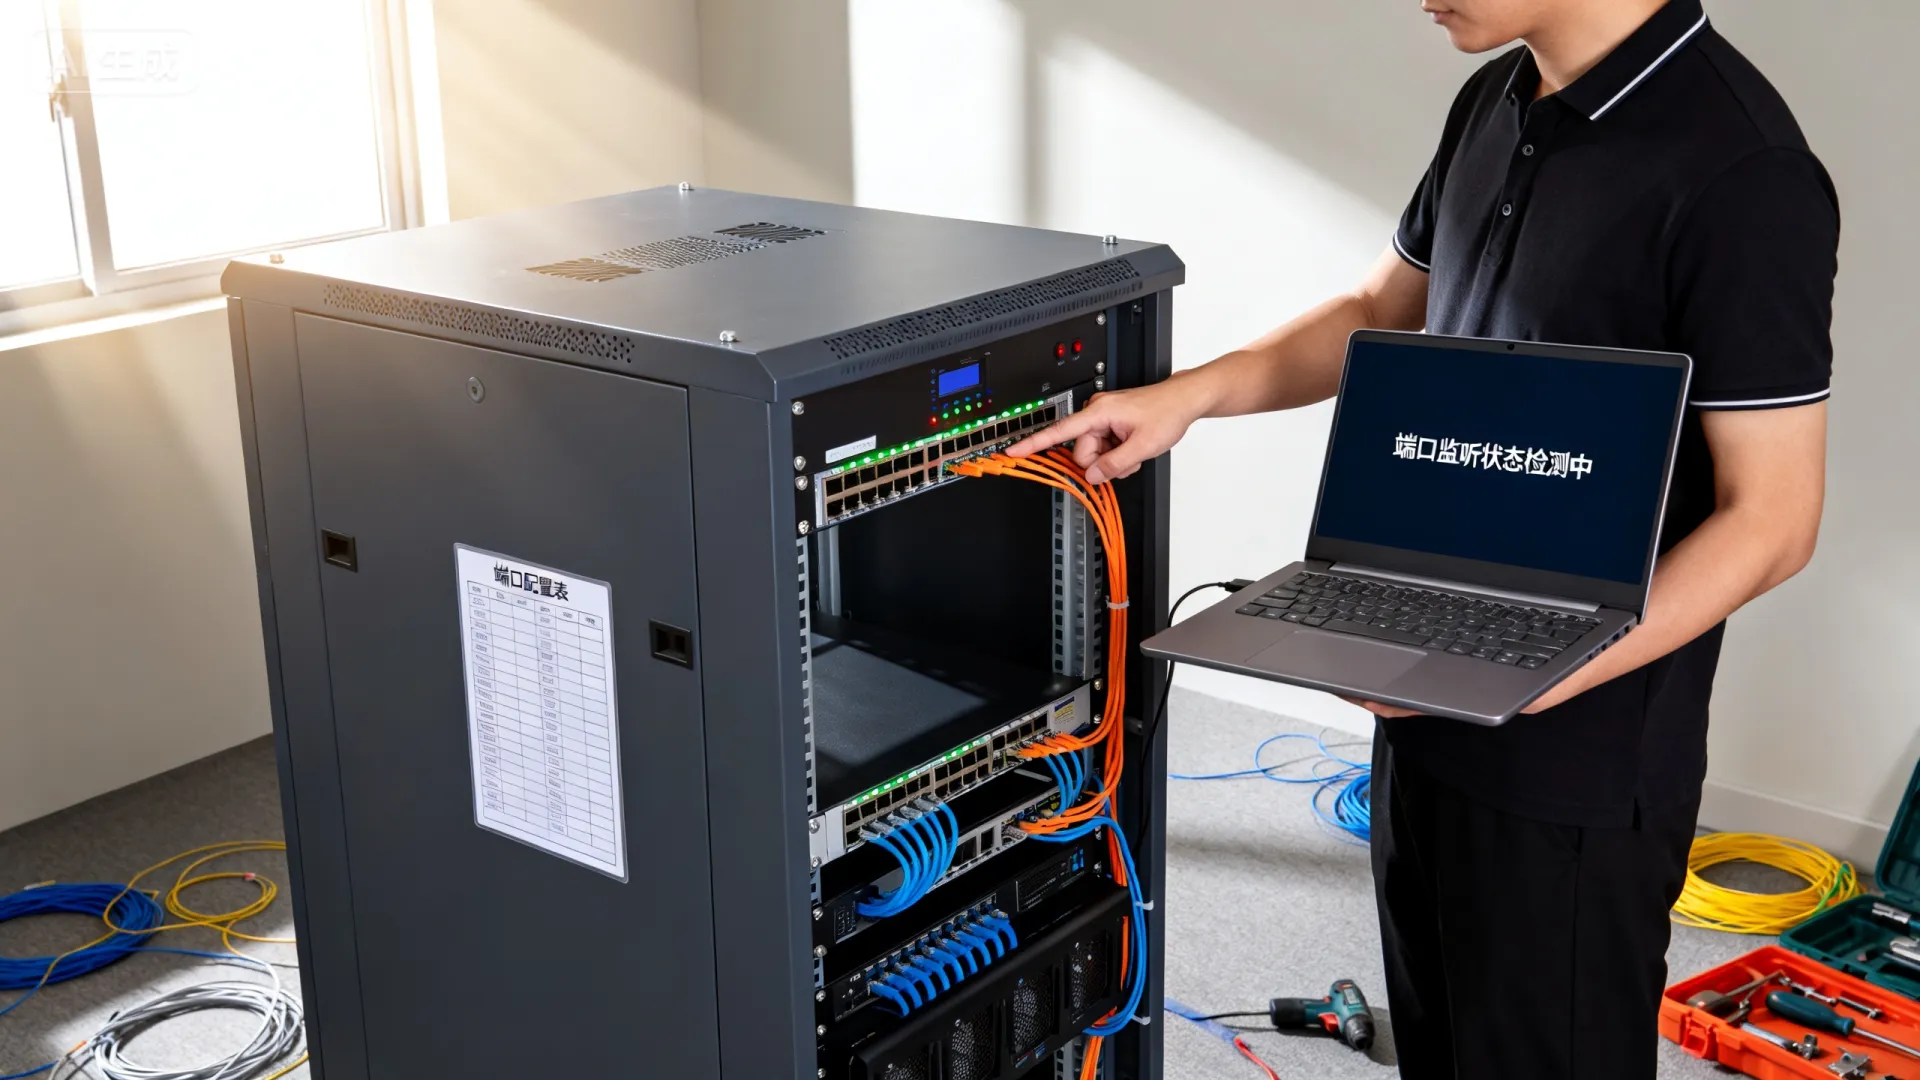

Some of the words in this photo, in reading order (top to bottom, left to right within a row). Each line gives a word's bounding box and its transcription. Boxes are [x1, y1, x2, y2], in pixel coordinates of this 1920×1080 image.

[1393, 432, 1593, 480] 端口监听状态检测中
